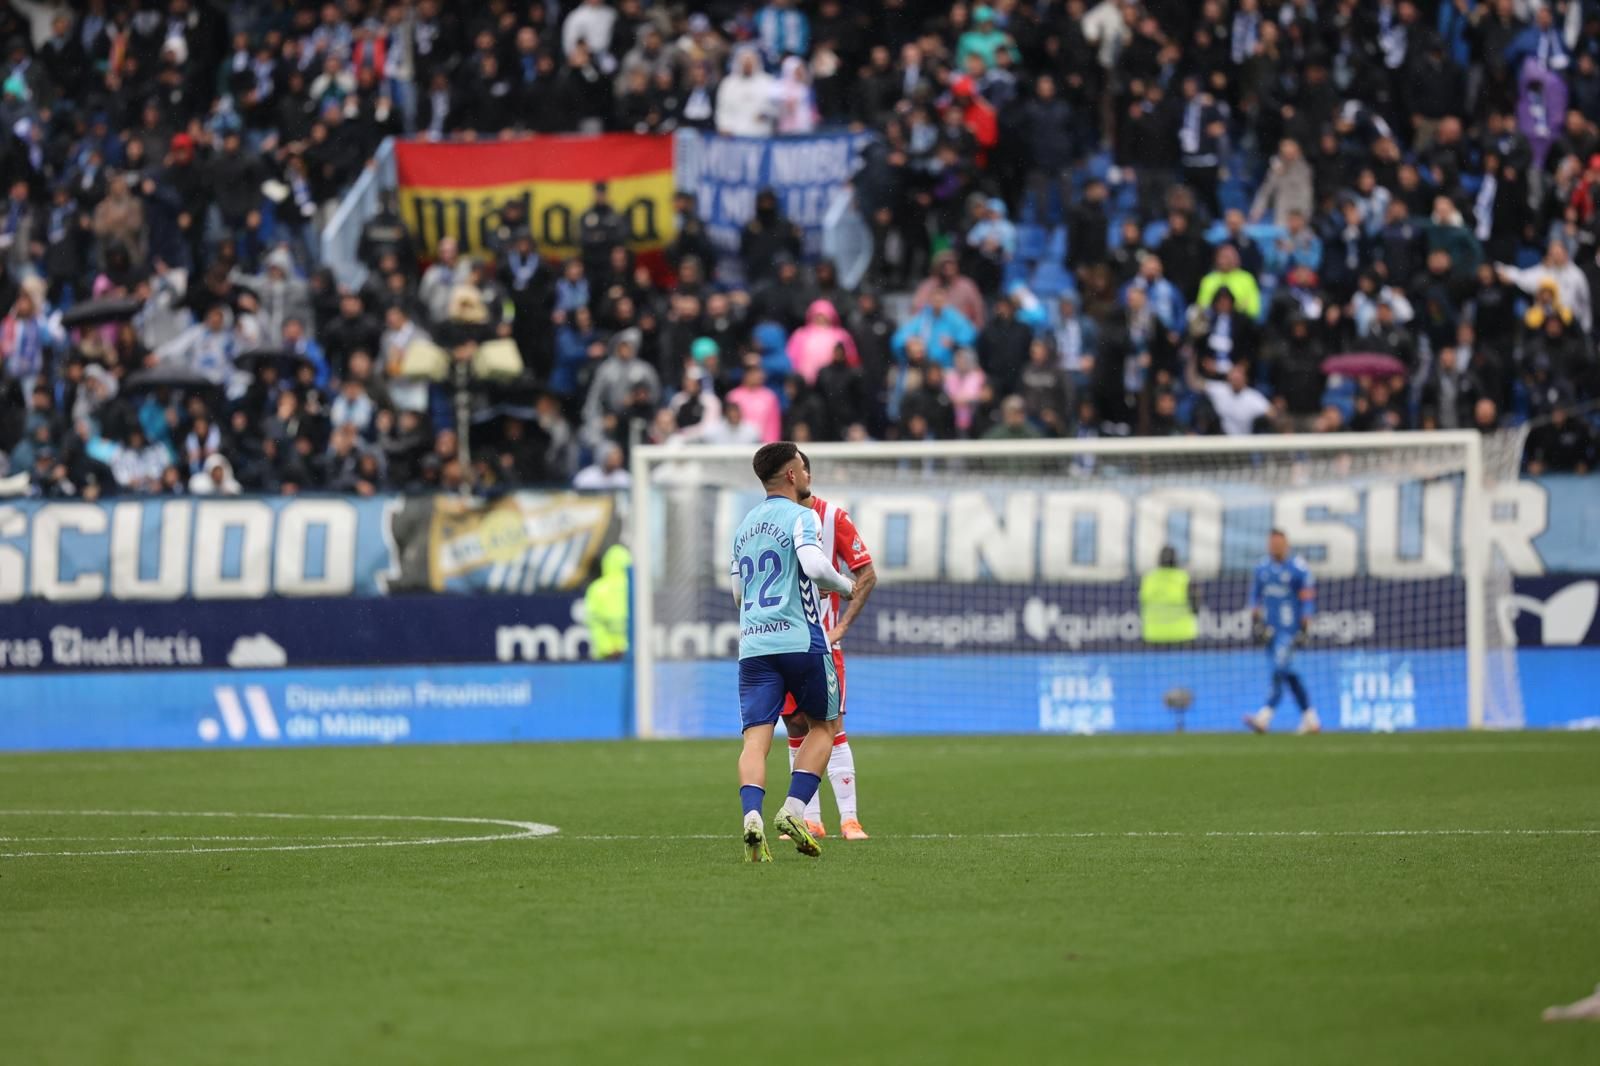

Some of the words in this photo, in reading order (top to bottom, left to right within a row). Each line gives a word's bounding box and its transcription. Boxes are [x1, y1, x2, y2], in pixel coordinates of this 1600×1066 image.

[750, 521, 791, 549] LORENZO
[830, 487, 1223, 583] ONDO
[1273, 479, 1548, 581] SUR
[739, 549, 783, 612] 22
[877, 608, 1016, 648] Hospital
[414, 679, 532, 707] Provincial
[286, 714, 319, 737] de
[321, 712, 411, 742] Málaga
